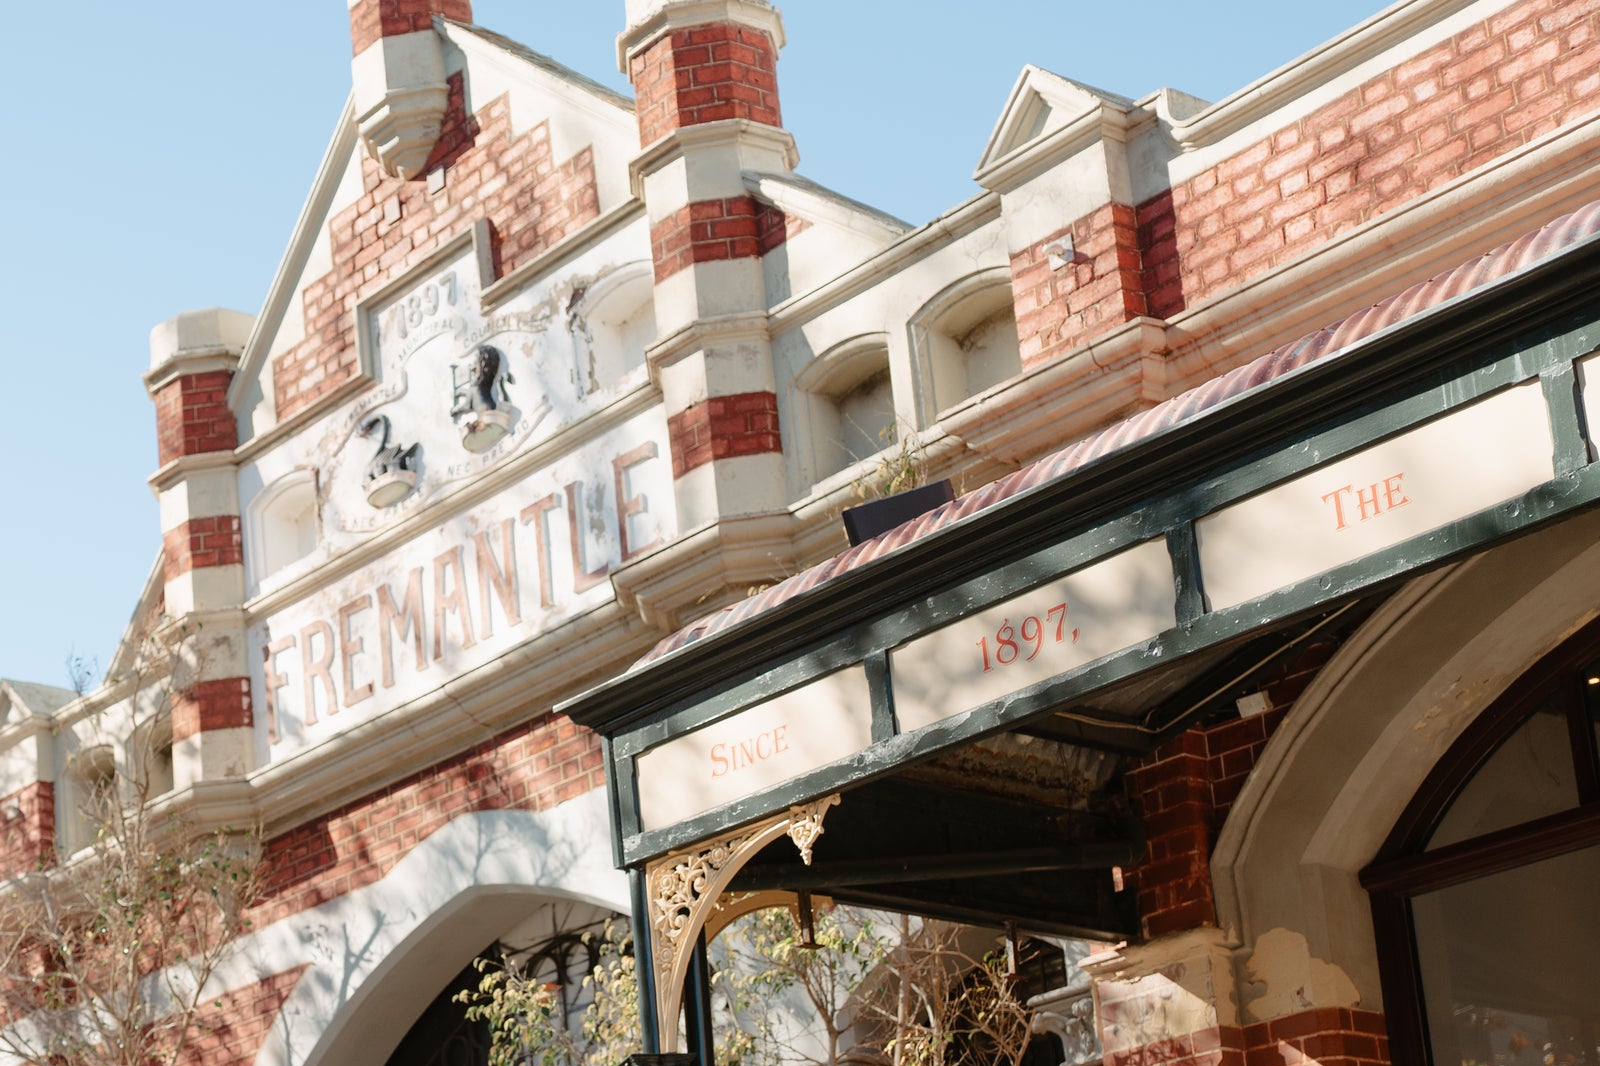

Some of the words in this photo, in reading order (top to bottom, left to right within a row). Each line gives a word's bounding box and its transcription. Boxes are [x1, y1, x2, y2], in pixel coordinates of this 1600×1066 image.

[397, 271, 457, 339] 1897
[448, 463, 472, 476] NEC
[483, 420, 529, 465] PREIO
[263, 441, 662, 745] FREMANTLE
[710, 724, 790, 777] SINCE
[976, 602, 1080, 673] 1897,
[1321, 472, 1412, 533] THE
